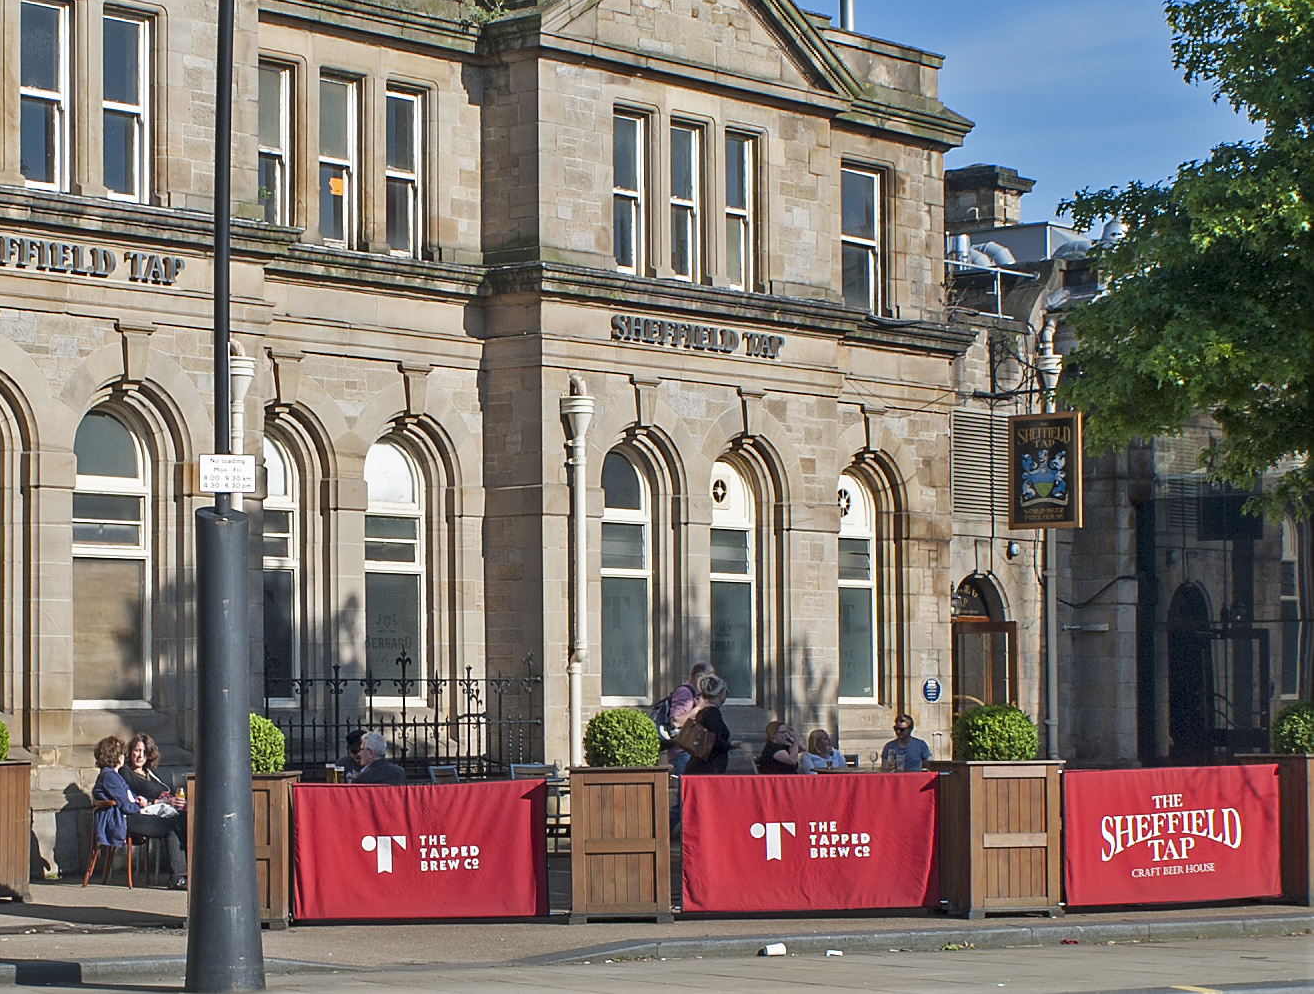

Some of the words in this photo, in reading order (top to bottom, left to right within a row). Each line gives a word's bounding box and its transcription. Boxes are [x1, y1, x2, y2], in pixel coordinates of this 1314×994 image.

[123, 251, 185, 286] TAP
[611, 315, 739, 353] SHEFFIELD
[741, 331, 785, 360] TAP
[1017, 426, 1071, 446] SHEFFIELD
[1034, 439, 1055, 448] TAP
[1152, 793, 1184, 809] THE
[808, 821, 837, 833] THE
[1101, 807, 1242, 862] SHEFFIELD
[419, 834, 447, 846] THE
[809, 832, 871, 846] TAPPED
[419, 845, 480, 859] TAPPED
[809, 846, 850, 859] BREW
[1147, 837, 1196, 861] TAP
[420, 859, 460, 872] BREW
[1131, 866, 1162, 878] CRAFT
[1163, 865, 1184, 876] BEER
[1185, 862, 1216, 874] HOUSE
